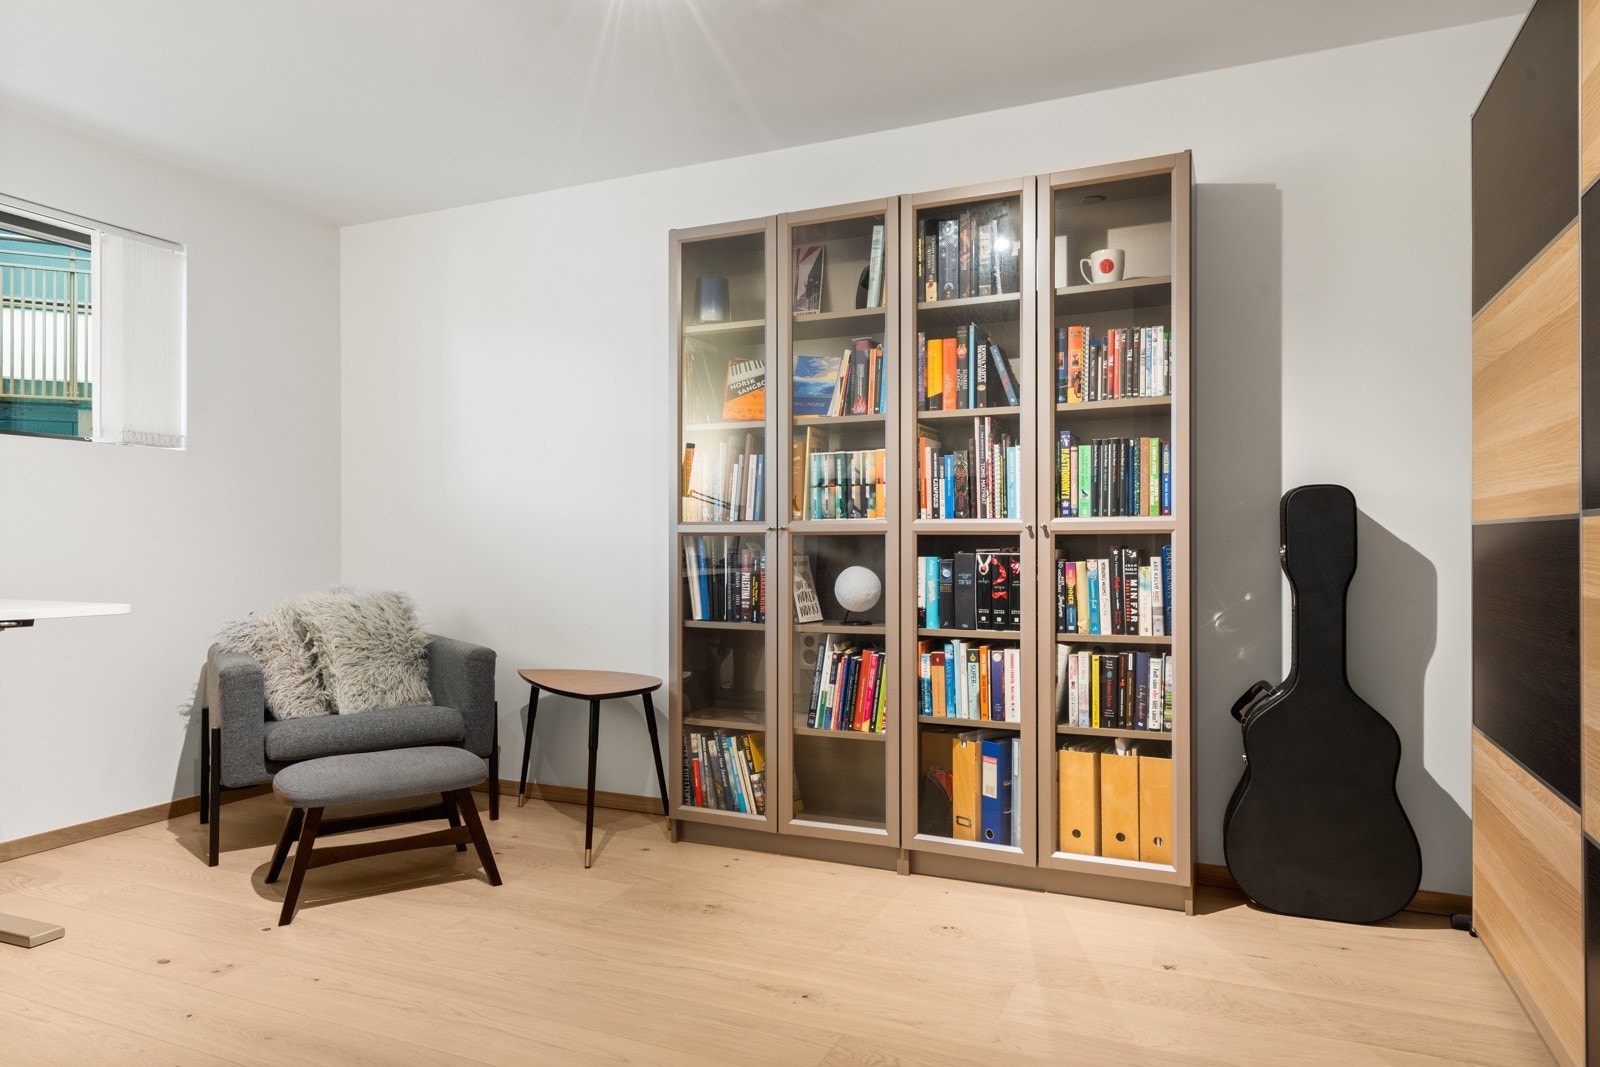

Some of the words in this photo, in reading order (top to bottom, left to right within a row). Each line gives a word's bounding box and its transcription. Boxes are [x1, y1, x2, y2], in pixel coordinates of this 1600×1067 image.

[730, 378, 756, 390] NORSK
[1062, 453, 1070, 495] ASTRONOMY
[742, 572, 750, 599] PALESTINA
